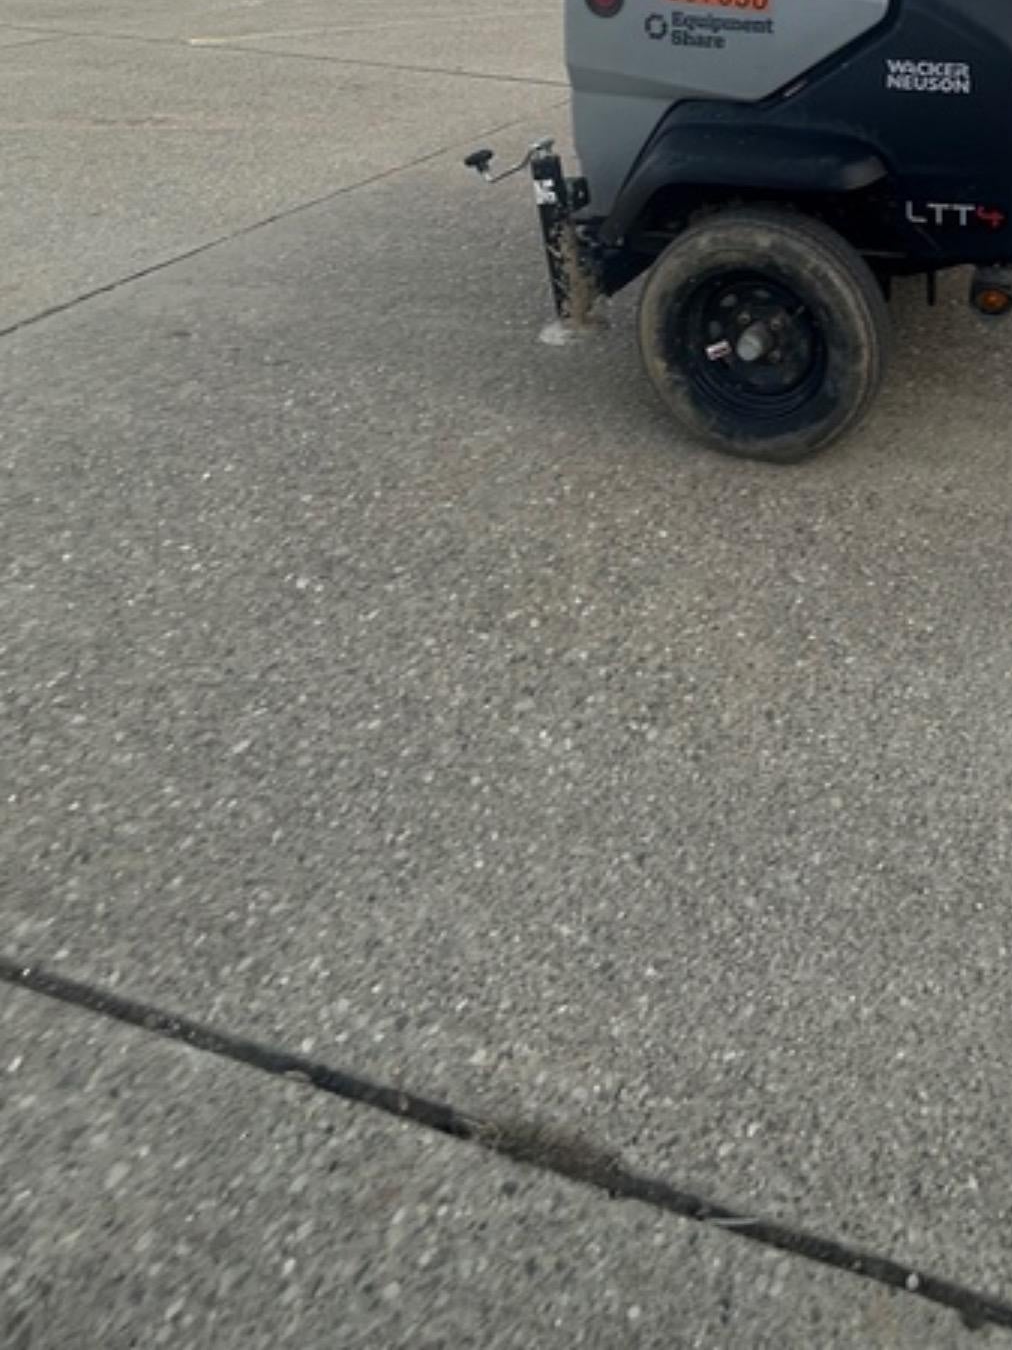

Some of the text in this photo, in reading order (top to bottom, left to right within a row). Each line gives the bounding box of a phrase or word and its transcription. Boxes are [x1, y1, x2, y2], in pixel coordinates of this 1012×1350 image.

[671, 11, 773, 34] Equipment
[671, 29, 726, 49] Share
[886, 58, 970, 77] WACKER
[886, 73, 970, 95] NEUSON
[904, 200, 1004, 229] LTT4
